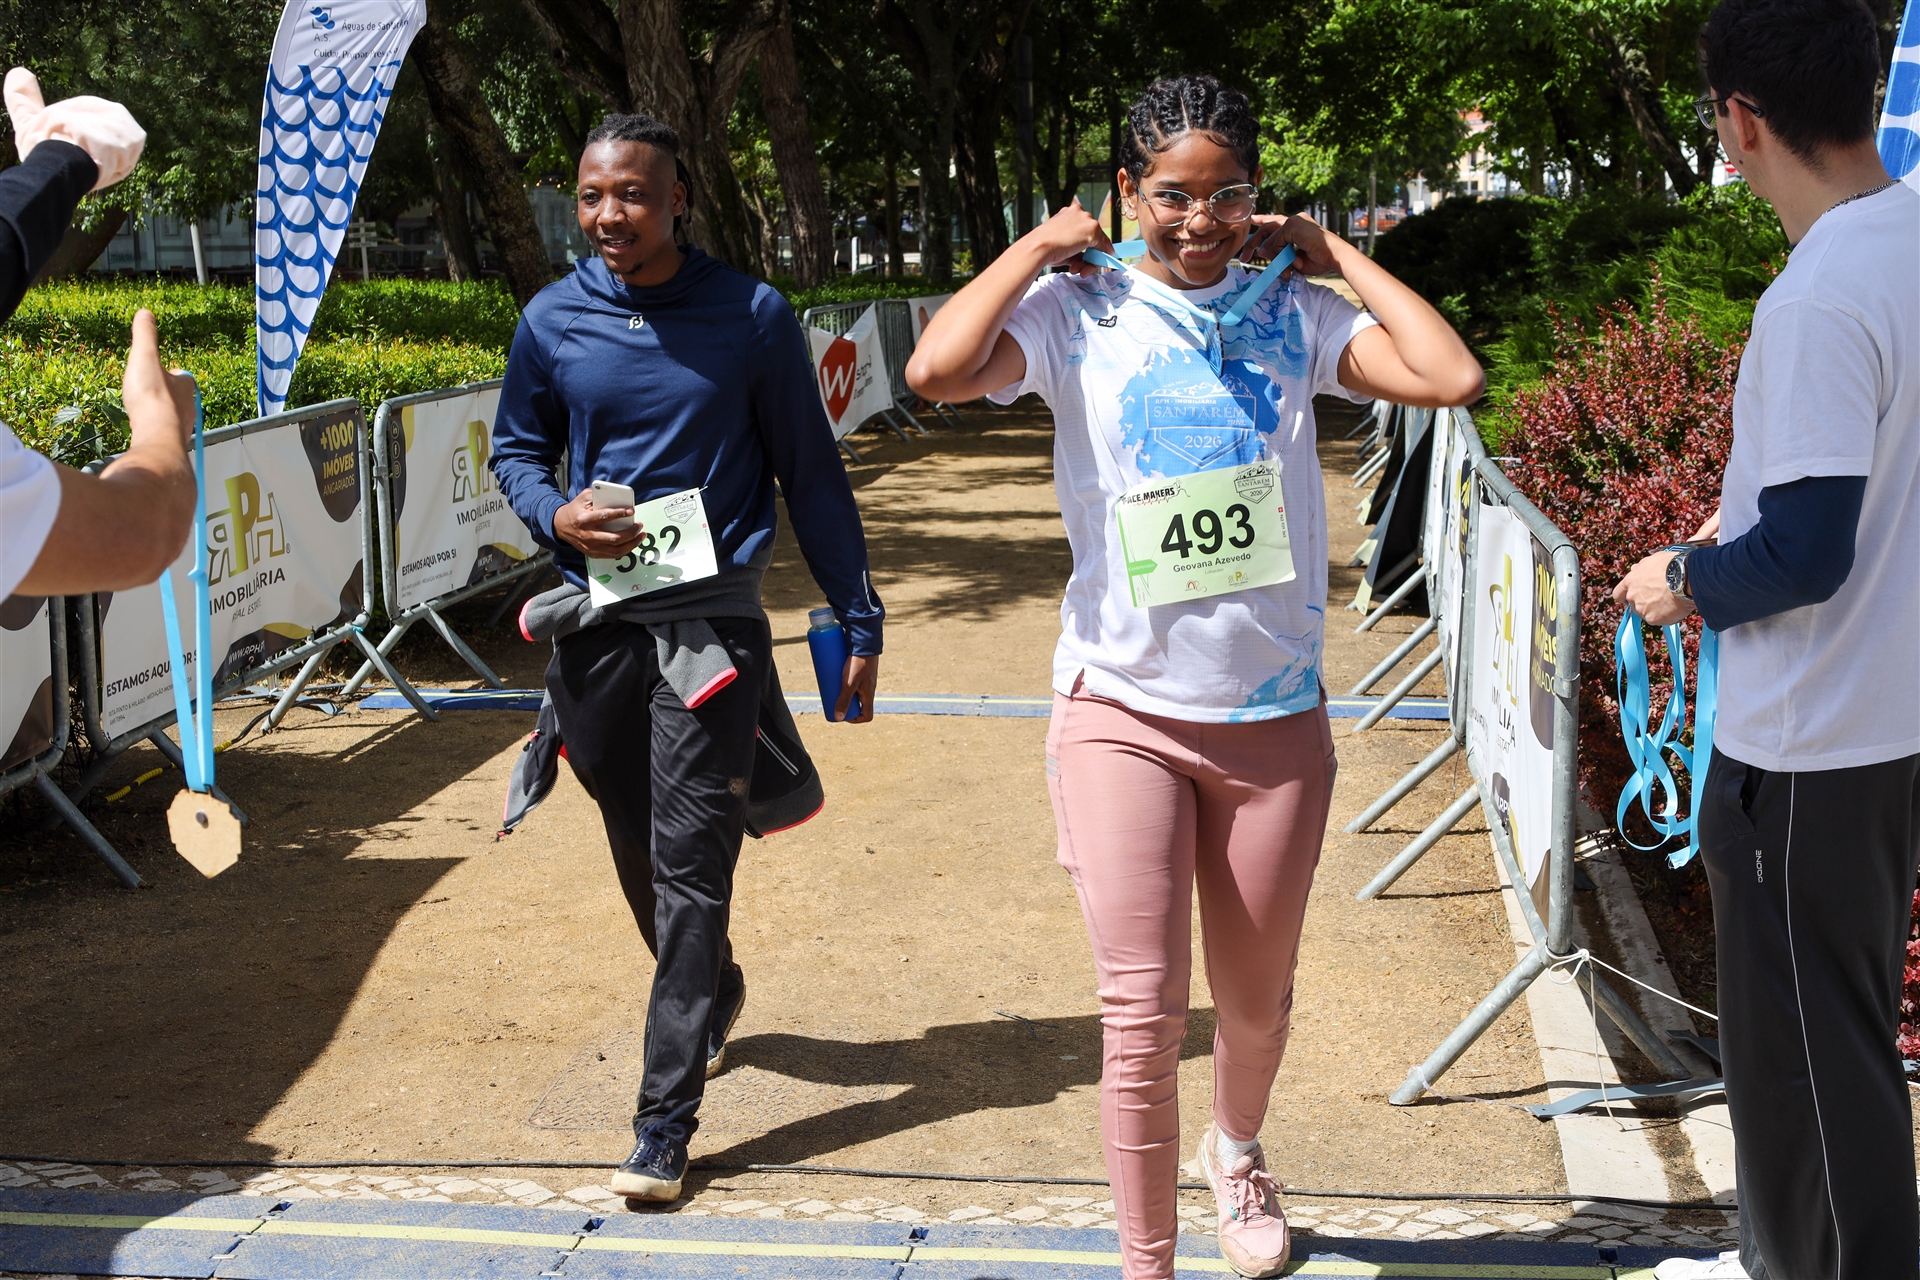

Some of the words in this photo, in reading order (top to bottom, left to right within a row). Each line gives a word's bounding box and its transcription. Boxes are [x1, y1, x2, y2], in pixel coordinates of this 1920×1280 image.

[341, 19, 365, 32] Águas
[366, 21, 376, 31] de
[313, 33, 331, 42] A.S.
[1153, 403, 1246, 418] SANTARÉM
[320, 419, 354, 452] +1000
[1184, 434, 1222, 449] 2026
[323, 451, 355, 480] IMÓVEIS
[323, 473, 355, 496] ANGARIADOS
[1237, 478, 1271, 488] SANTARÉM
[1160, 503, 1255, 559] 493
[402, 559, 423, 577] ESTAMOS
[423, 554, 437, 568] AQUI
[436, 550, 451, 564] POR
[451, 548, 457, 559] SI
[1173, 561, 1213, 573] Geovana
[1214, 552, 1252, 566] Azevedo
[209, 567, 286, 616] IMOBILIÁRIA
[106, 669, 151, 698] ESTAMOS
[150, 660, 171, 681] AQU
